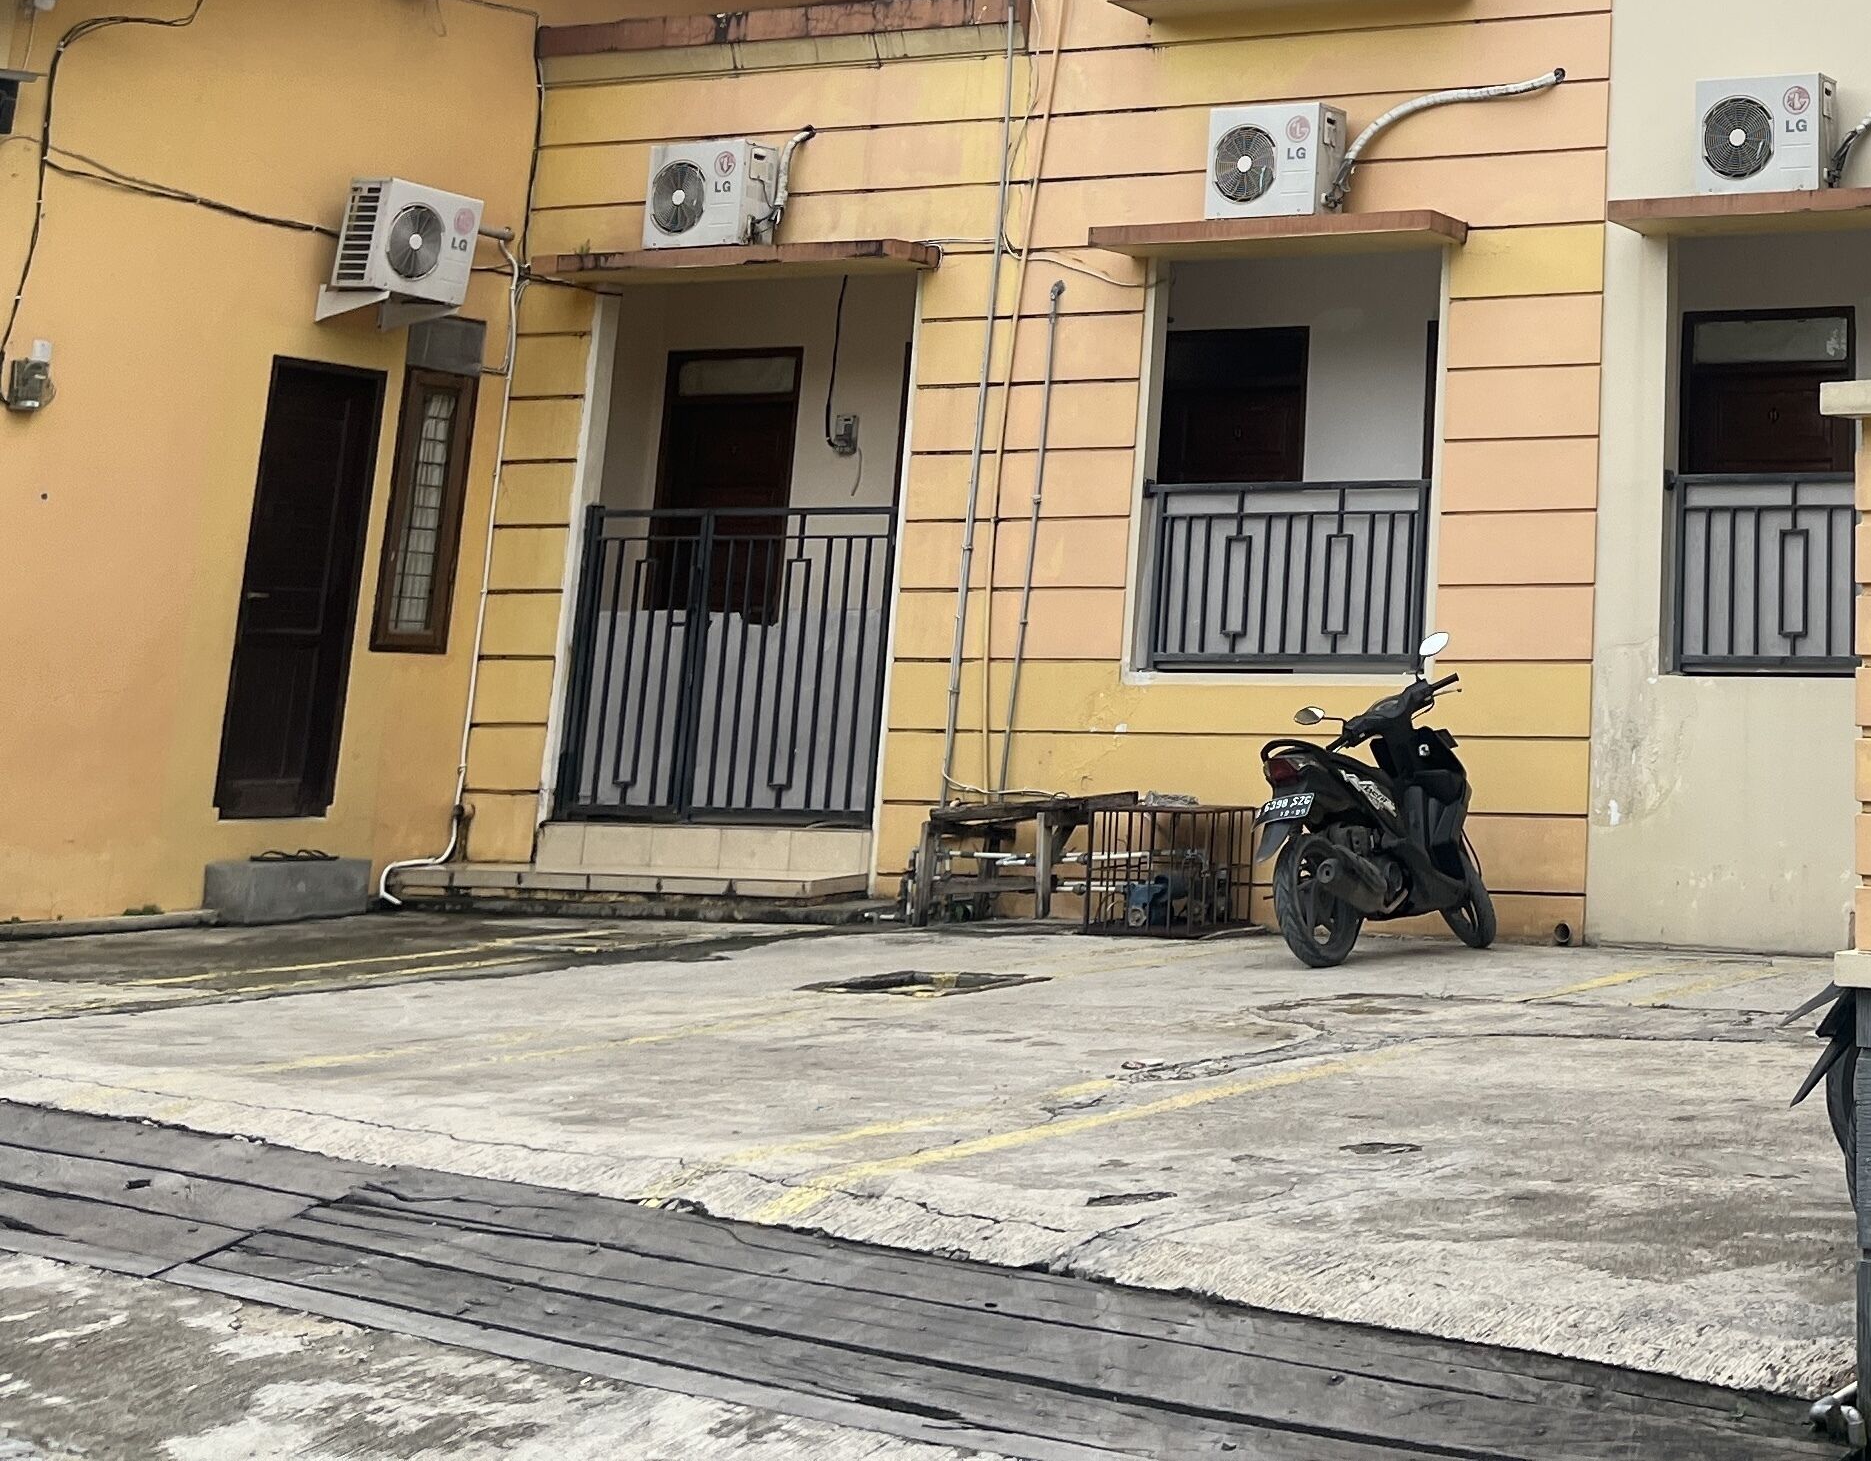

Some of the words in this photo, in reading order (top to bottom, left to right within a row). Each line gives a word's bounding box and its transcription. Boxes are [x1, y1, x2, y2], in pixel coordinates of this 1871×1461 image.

[1785, 119, 1807, 132] LG
[1287, 147, 1306, 160] LG
[714, 181, 731, 193] LG
[451, 237, 467, 252] LG
